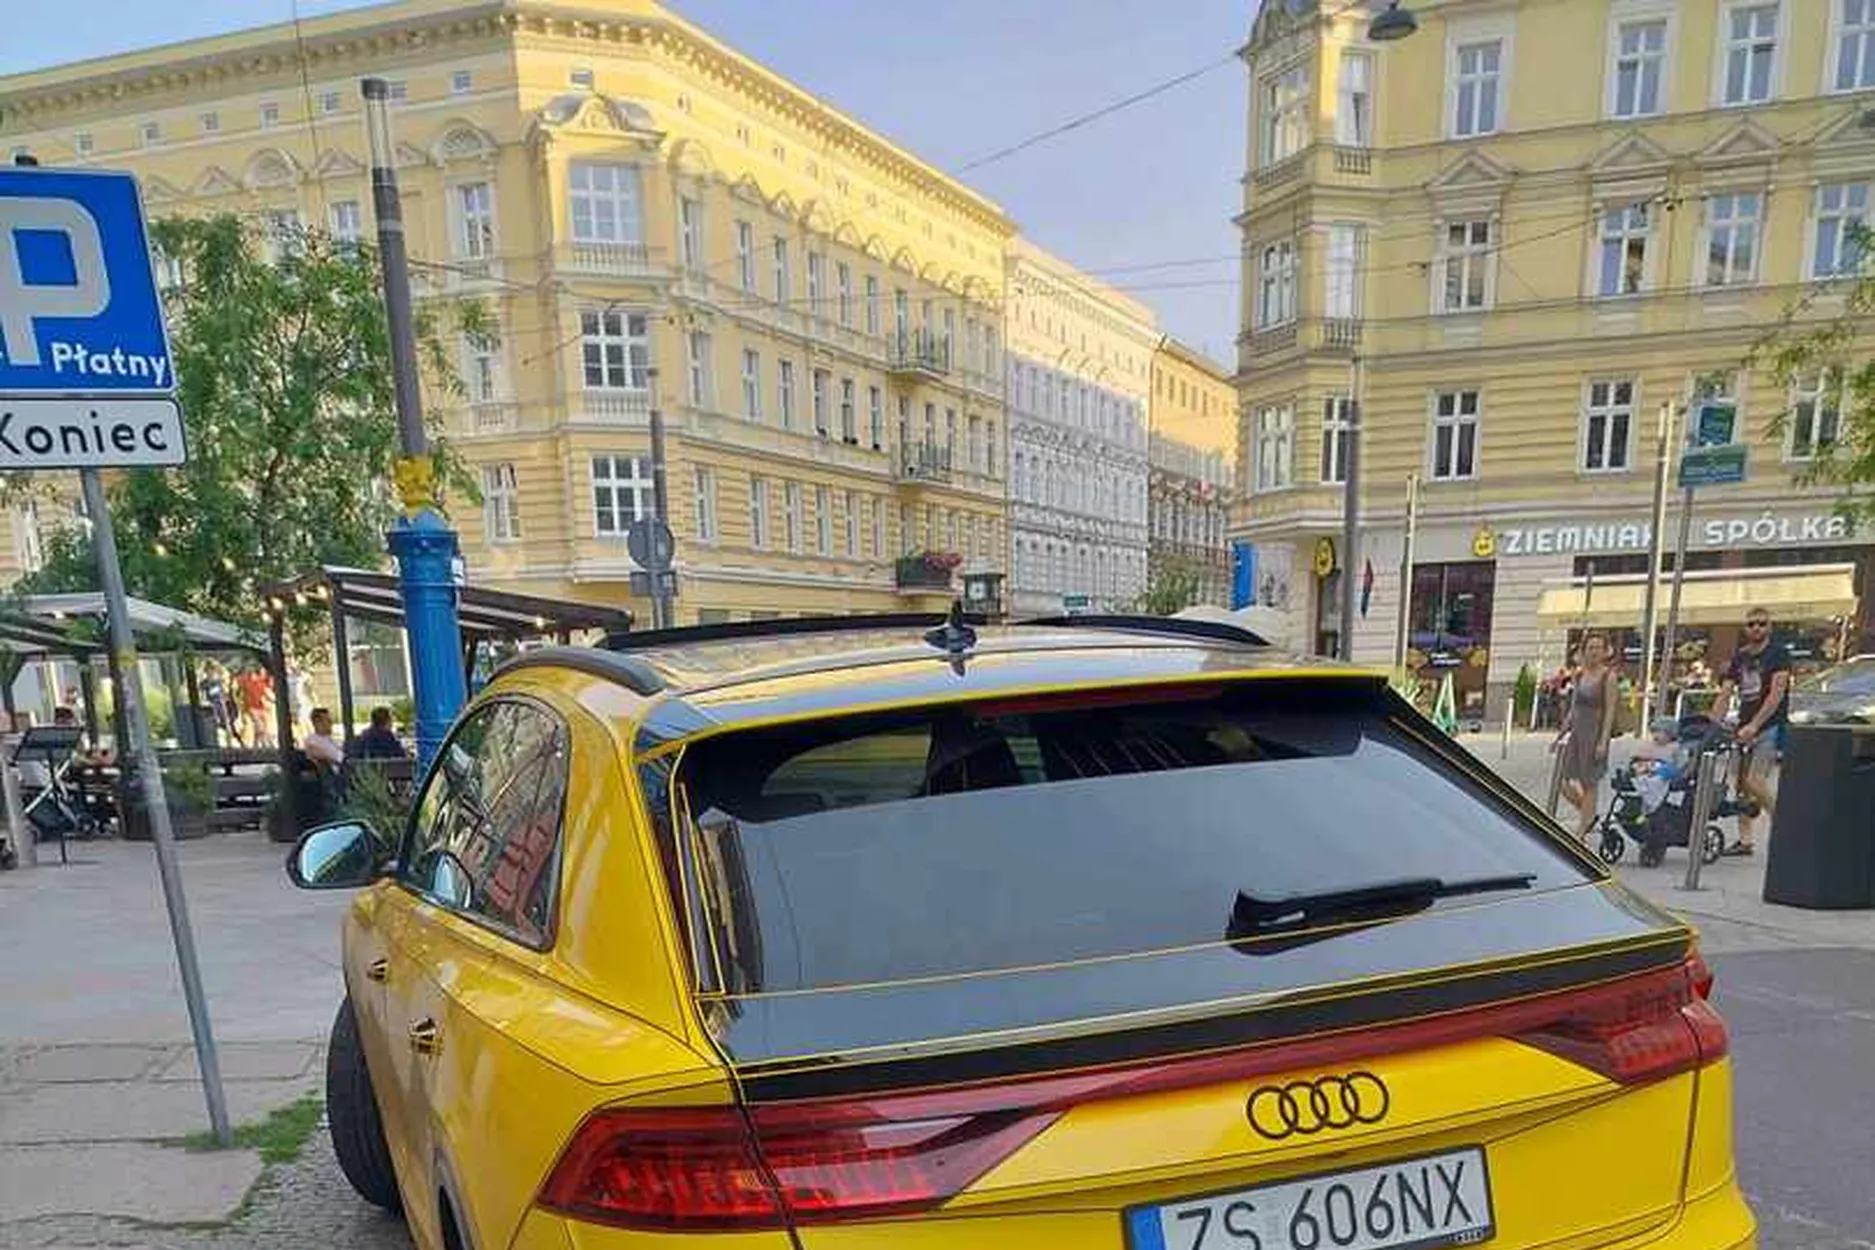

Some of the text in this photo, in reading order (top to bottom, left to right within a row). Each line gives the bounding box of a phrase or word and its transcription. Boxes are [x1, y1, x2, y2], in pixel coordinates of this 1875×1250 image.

[0, 197, 111, 366] P
[51, 341, 165, 386] Płatny
[0, 411, 168, 455] Koniec
